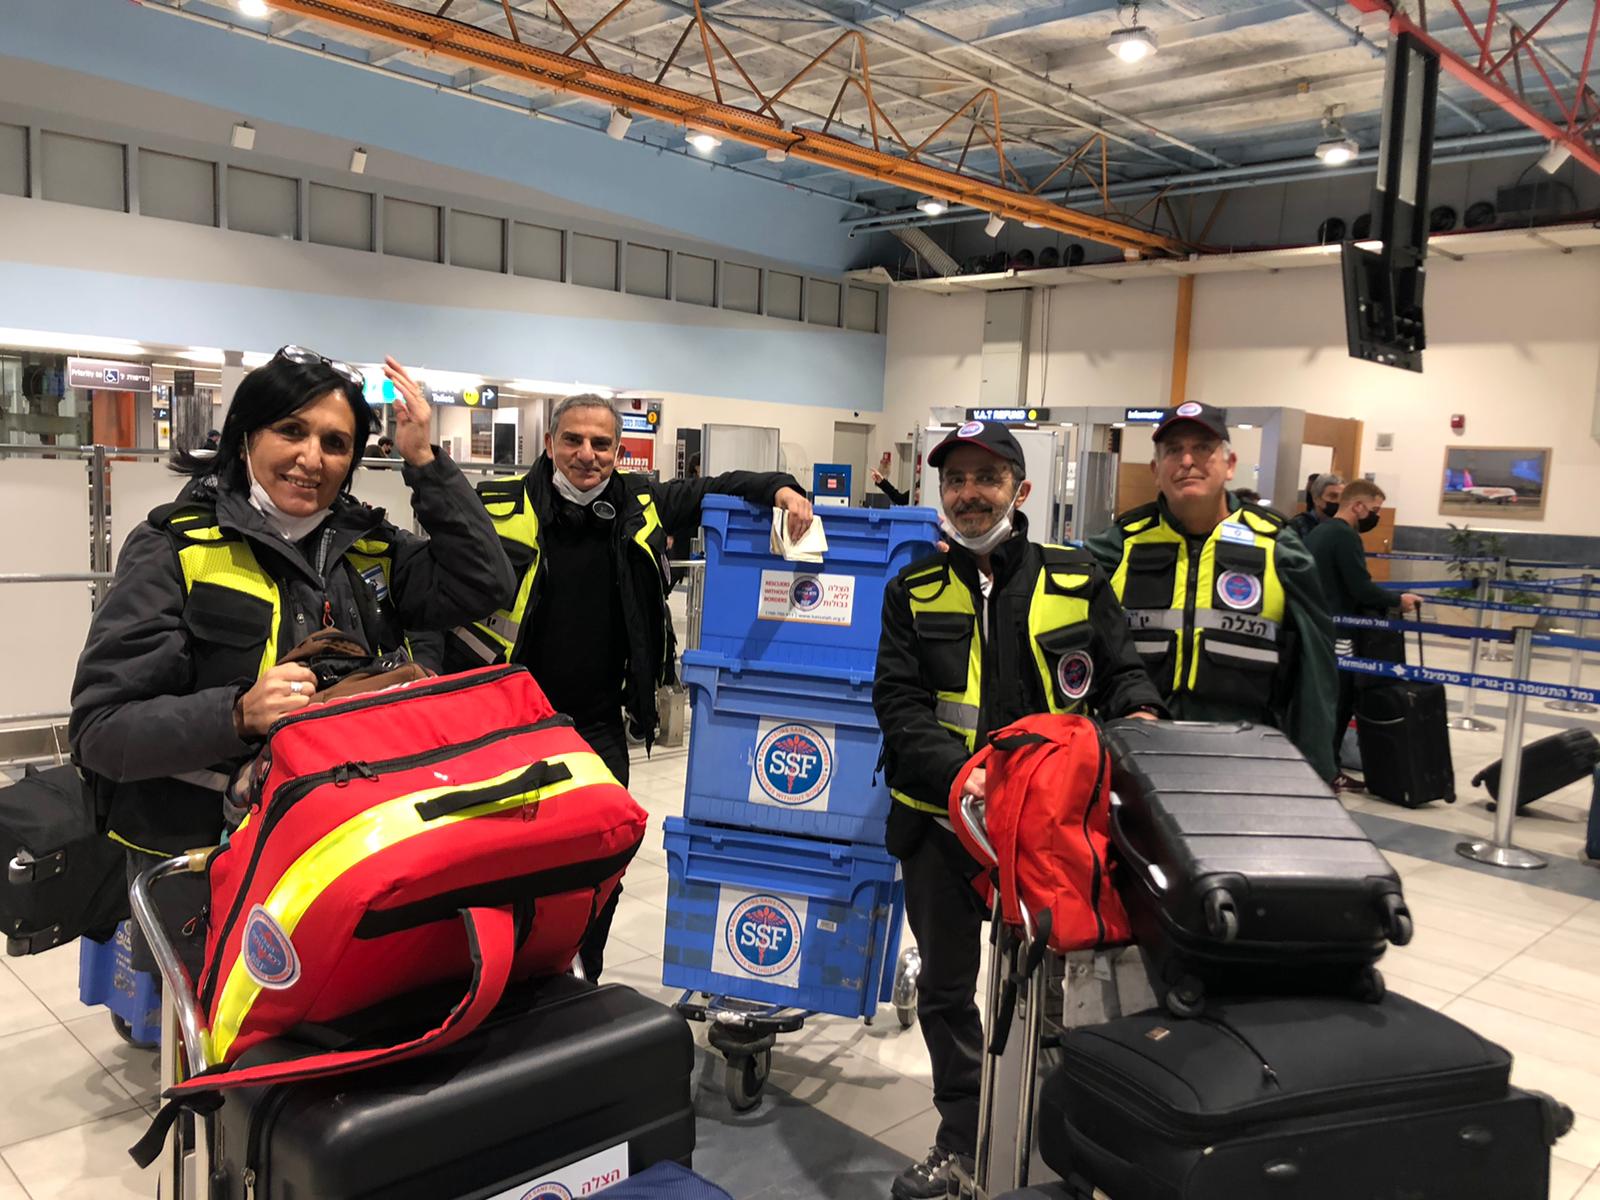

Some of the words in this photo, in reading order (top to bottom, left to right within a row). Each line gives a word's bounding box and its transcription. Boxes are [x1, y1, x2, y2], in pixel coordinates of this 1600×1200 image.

[71, 368, 94, 378] Priority
[992, 409, 1026, 420] REFUND
[828, 584, 850, 593] הצלה
[833, 592, 849, 600] ללא
[823, 599, 848, 608] גבולות
[1221, 614, 1268, 636] הצלה
[1337, 657, 1376, 671] Terminal
[1379, 663, 1384, 671] 1
[1518, 682, 1568, 698] התעופה
[1569, 688, 1595, 702] נמל
[769, 750, 817, 778] SSF
[740, 921, 787, 950] SSF
[581, 1167, 621, 1195] הצלה
